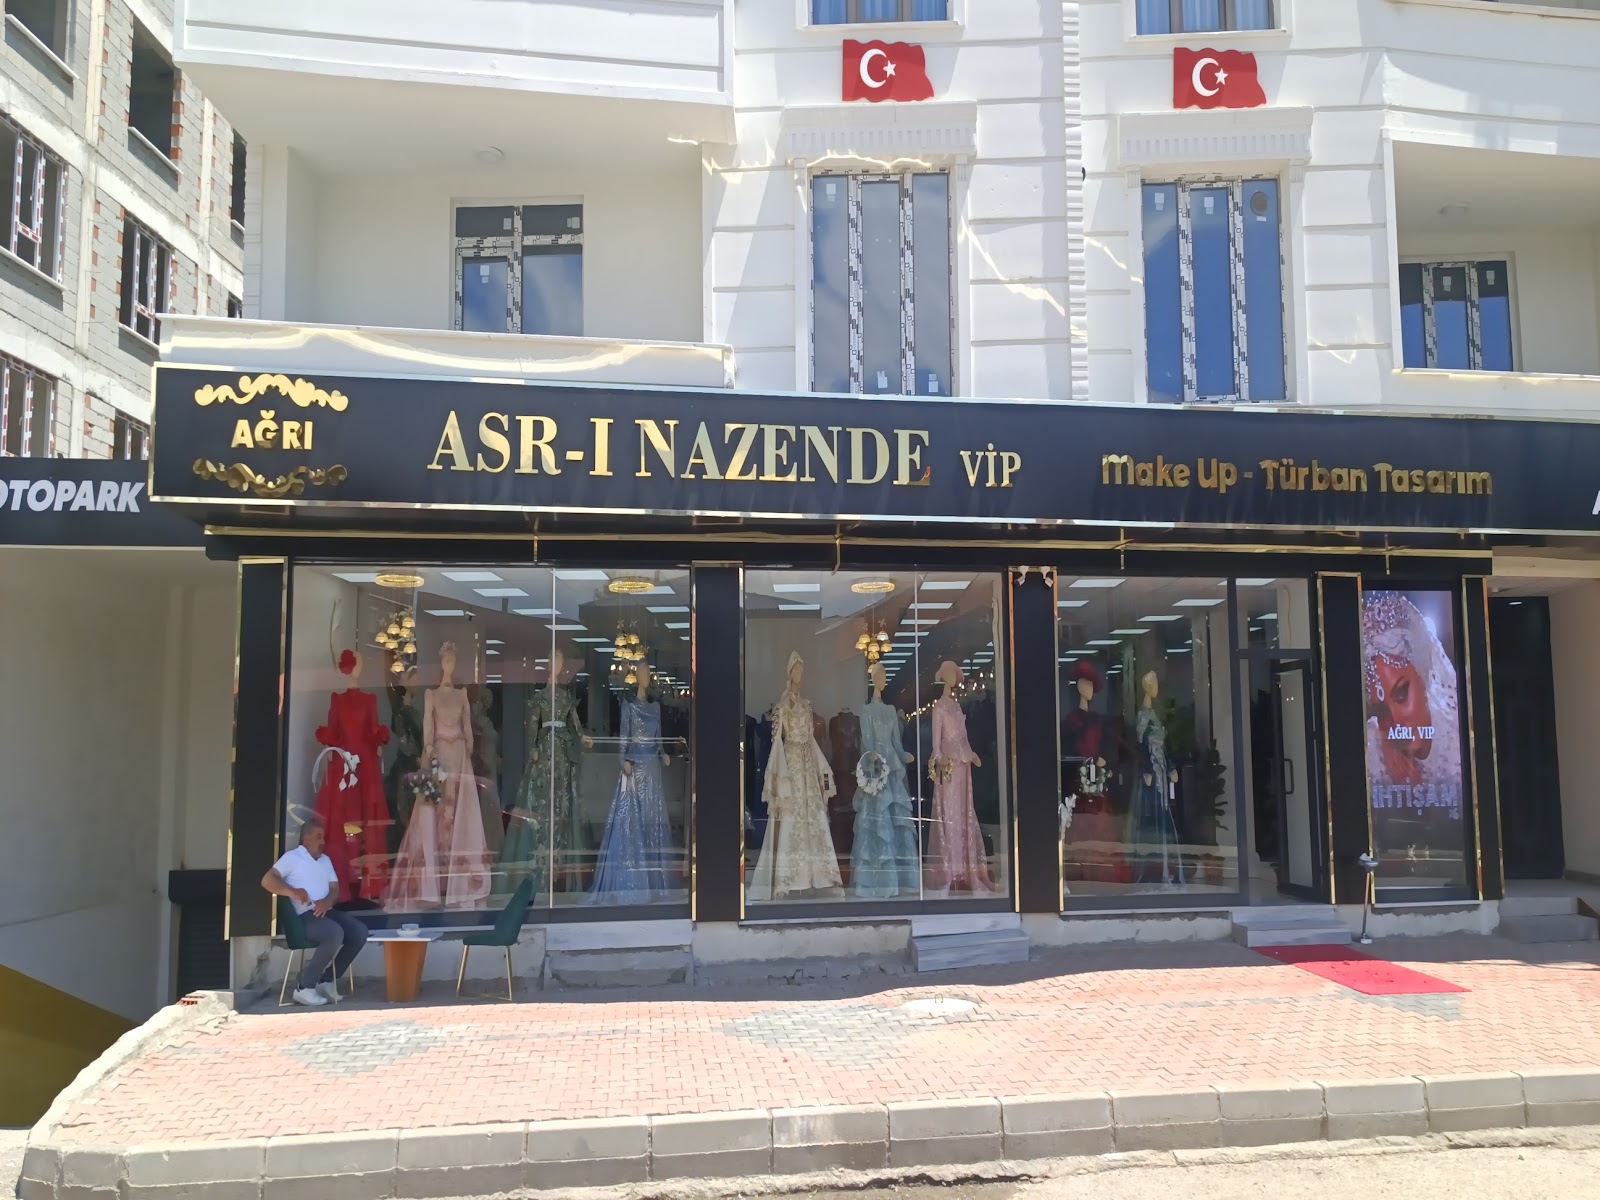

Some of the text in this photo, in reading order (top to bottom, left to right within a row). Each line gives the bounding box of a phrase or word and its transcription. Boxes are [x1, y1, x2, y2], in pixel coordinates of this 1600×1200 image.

[231, 409, 313, 451] AĞRI
[427, 409, 1022, 488] ASR-I NAZENDE VİP
[1101, 454, 1190, 488] Make
[1197, 458, 1238, 494] Up
[1259, 458, 1368, 493] Türban
[1373, 462, 1494, 495] Tasarım
[1417, 726, 1435, 739] VIP
